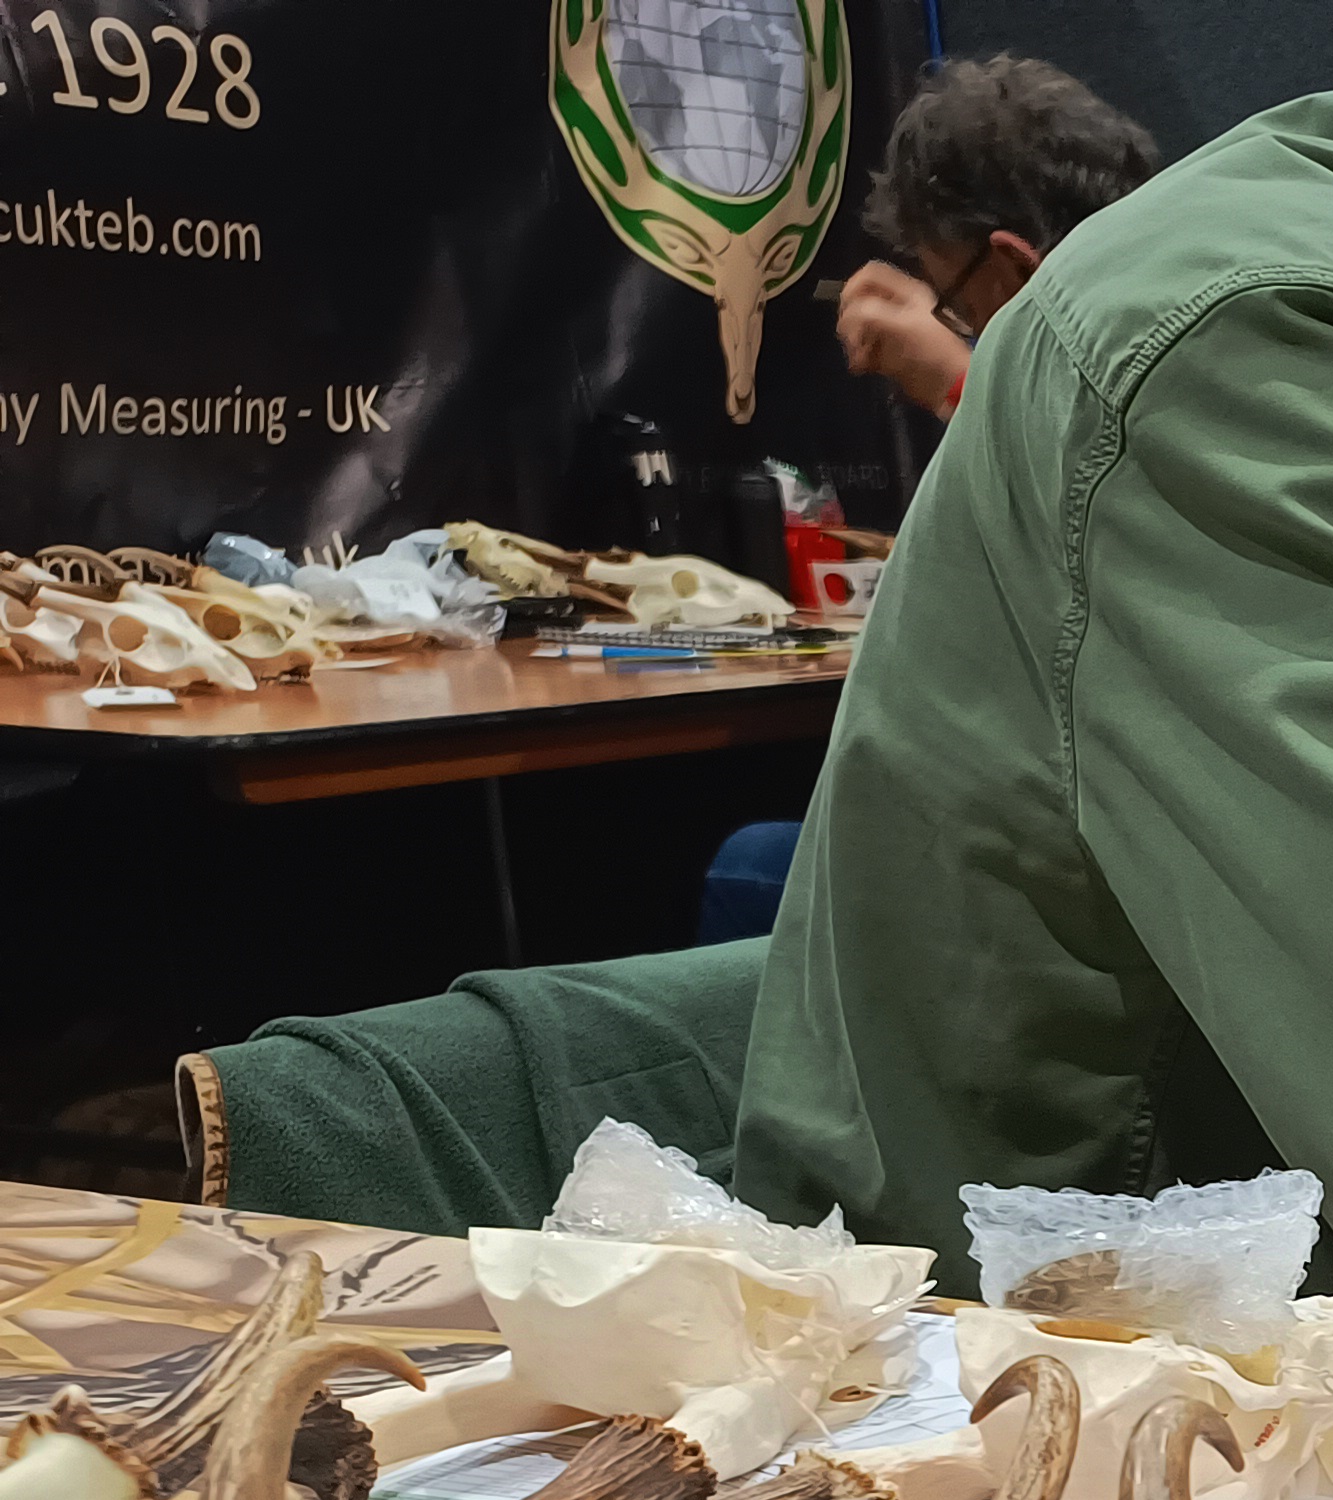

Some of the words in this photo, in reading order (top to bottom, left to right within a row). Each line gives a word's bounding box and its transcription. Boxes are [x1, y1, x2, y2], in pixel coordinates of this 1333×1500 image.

[31, 9, 261, 130] 1928
[60, 382, 288, 446] Measuring
[326, 384, 392, 433] UK
